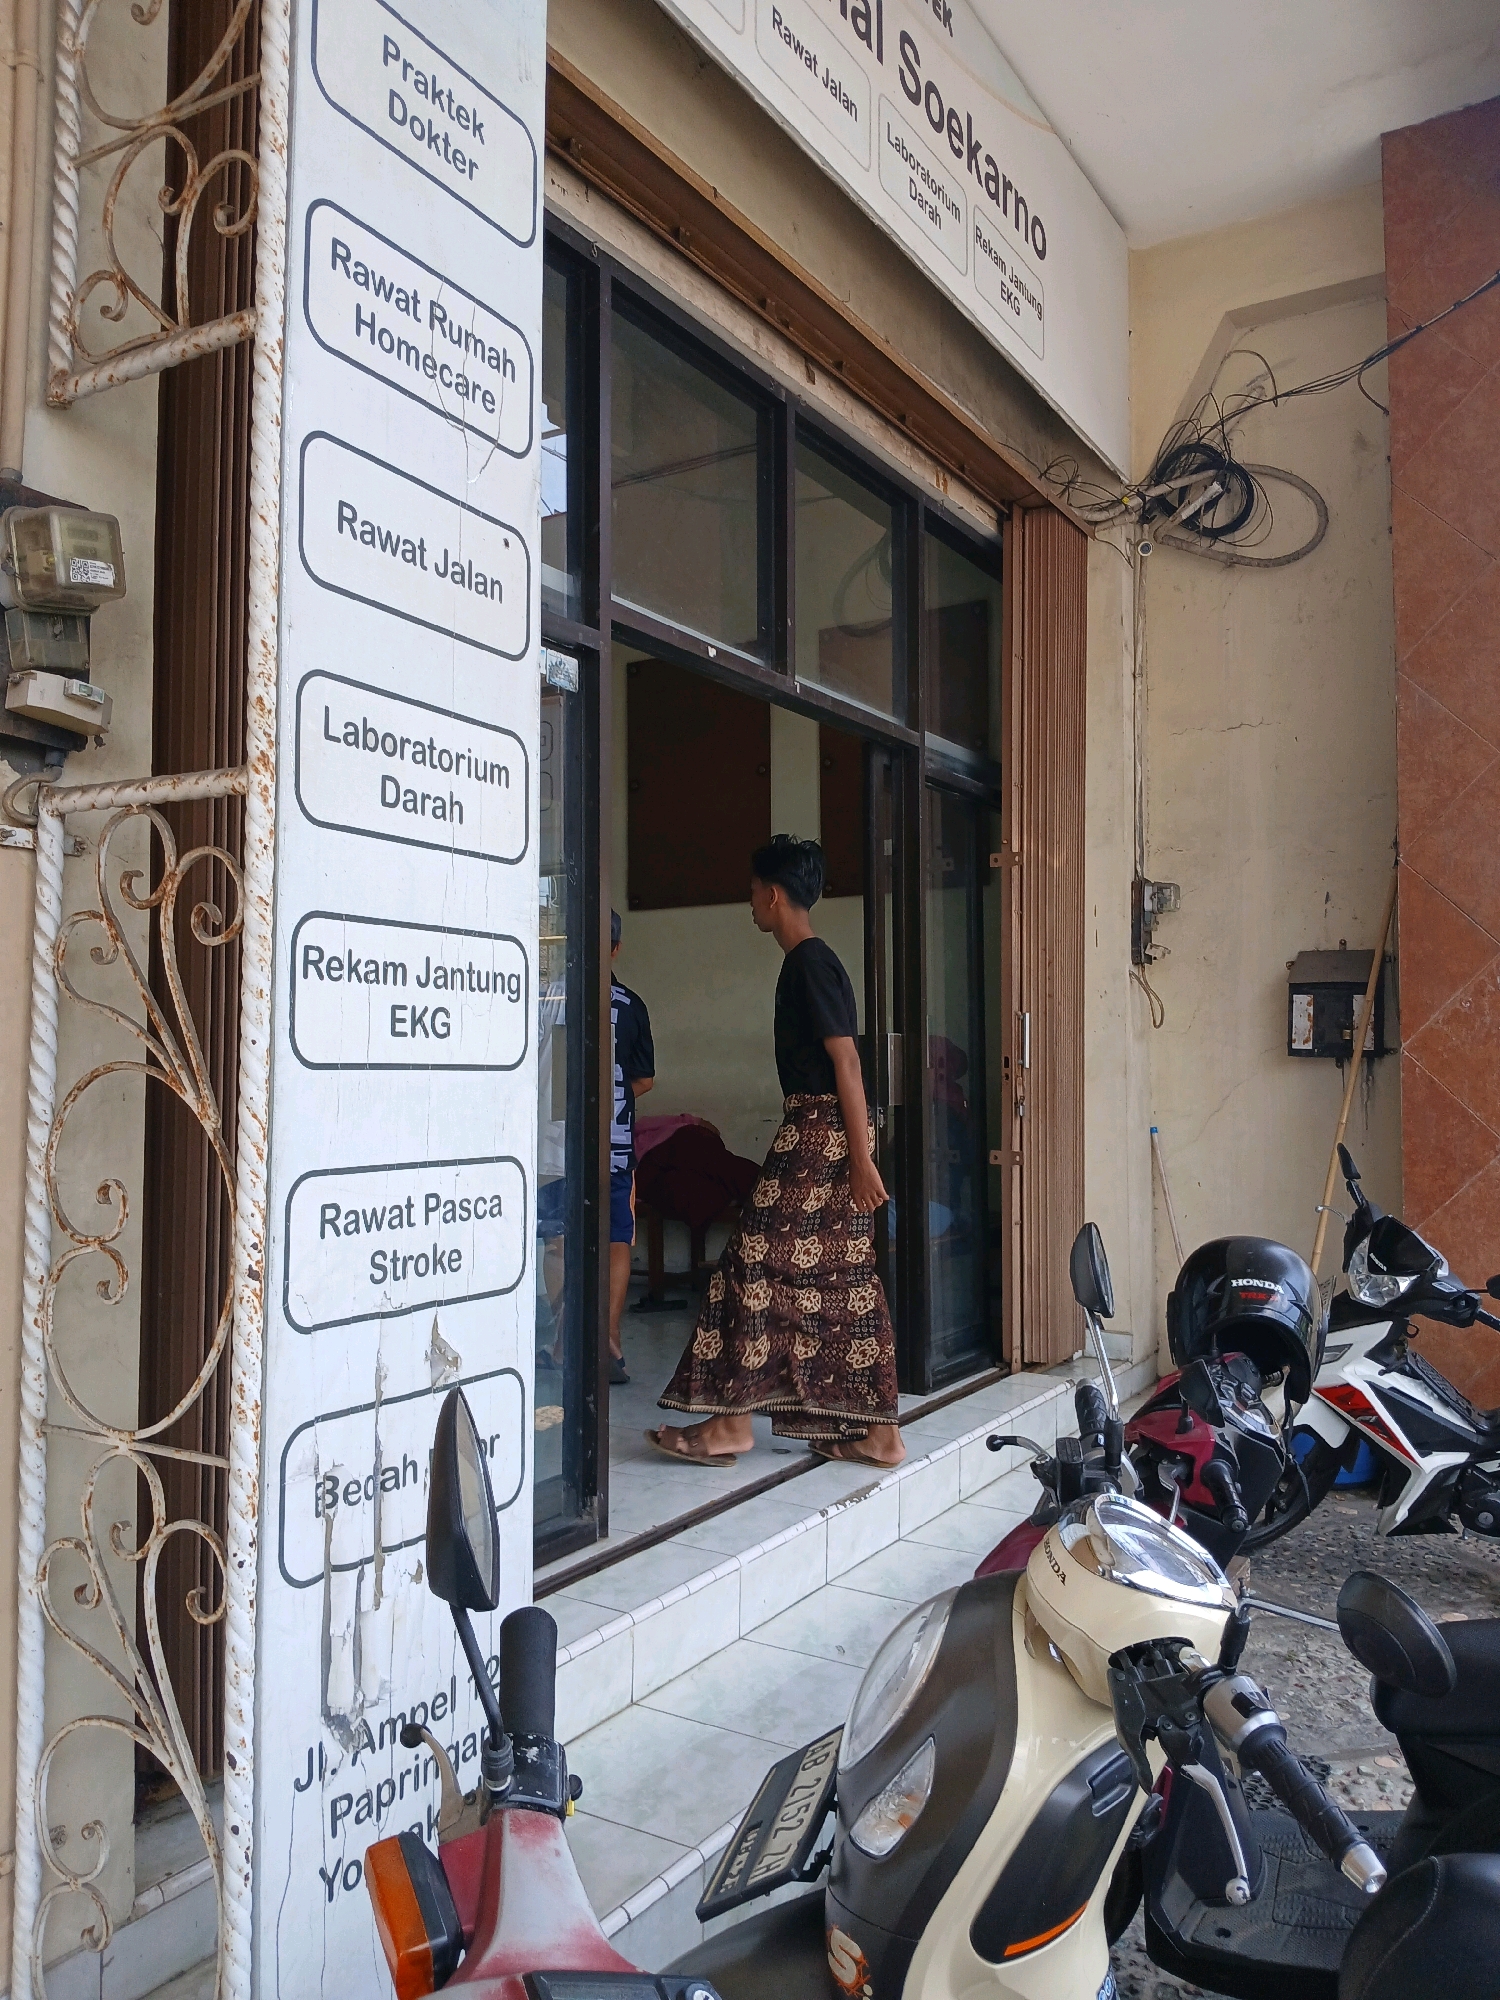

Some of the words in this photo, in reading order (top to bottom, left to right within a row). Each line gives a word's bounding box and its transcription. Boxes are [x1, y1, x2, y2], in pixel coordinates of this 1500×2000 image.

[382, 34, 485, 145] Praktek
[772, 5, 819, 78] Rawat
[822, 67, 858, 122] Jalan
[388, 88, 479, 181] Dokter
[898, 30, 1046, 260] Soekarno
[887, 121, 961, 224] Laboratorium
[909, 176, 942, 230] Darah
[975, 224, 1007, 276] Rekam
[1008, 265, 1043, 321] Jantung
[1000, 280, 1021, 316] EKG
[331, 236, 422, 323] Rawat
[429, 299, 516, 383] Rumah
[355, 303, 496, 414] Homecare
[337, 499, 428, 571] Rawat
[434, 548, 503, 604] Jalan
[324, 705, 510, 789] Laboratorium
[380, 774, 464, 825] Darah
[302, 944, 408, 988] Rekam
[415, 956, 521, 1003] Jantung
[390, 1004, 451, 1040] EKG
[320, 1195, 416, 1240] Rawat
[424, 1193, 503, 1226] Pasca
[369, 1242, 463, 1285] Stroke
[1230, 1278, 1285, 1295] HONDA
[1044, 1537, 1067, 1587] HONDA
[294, 1741, 338, 1793] Jl.
[801, 1741, 835, 1772] AB
[772, 1776, 822, 1840] 2152
